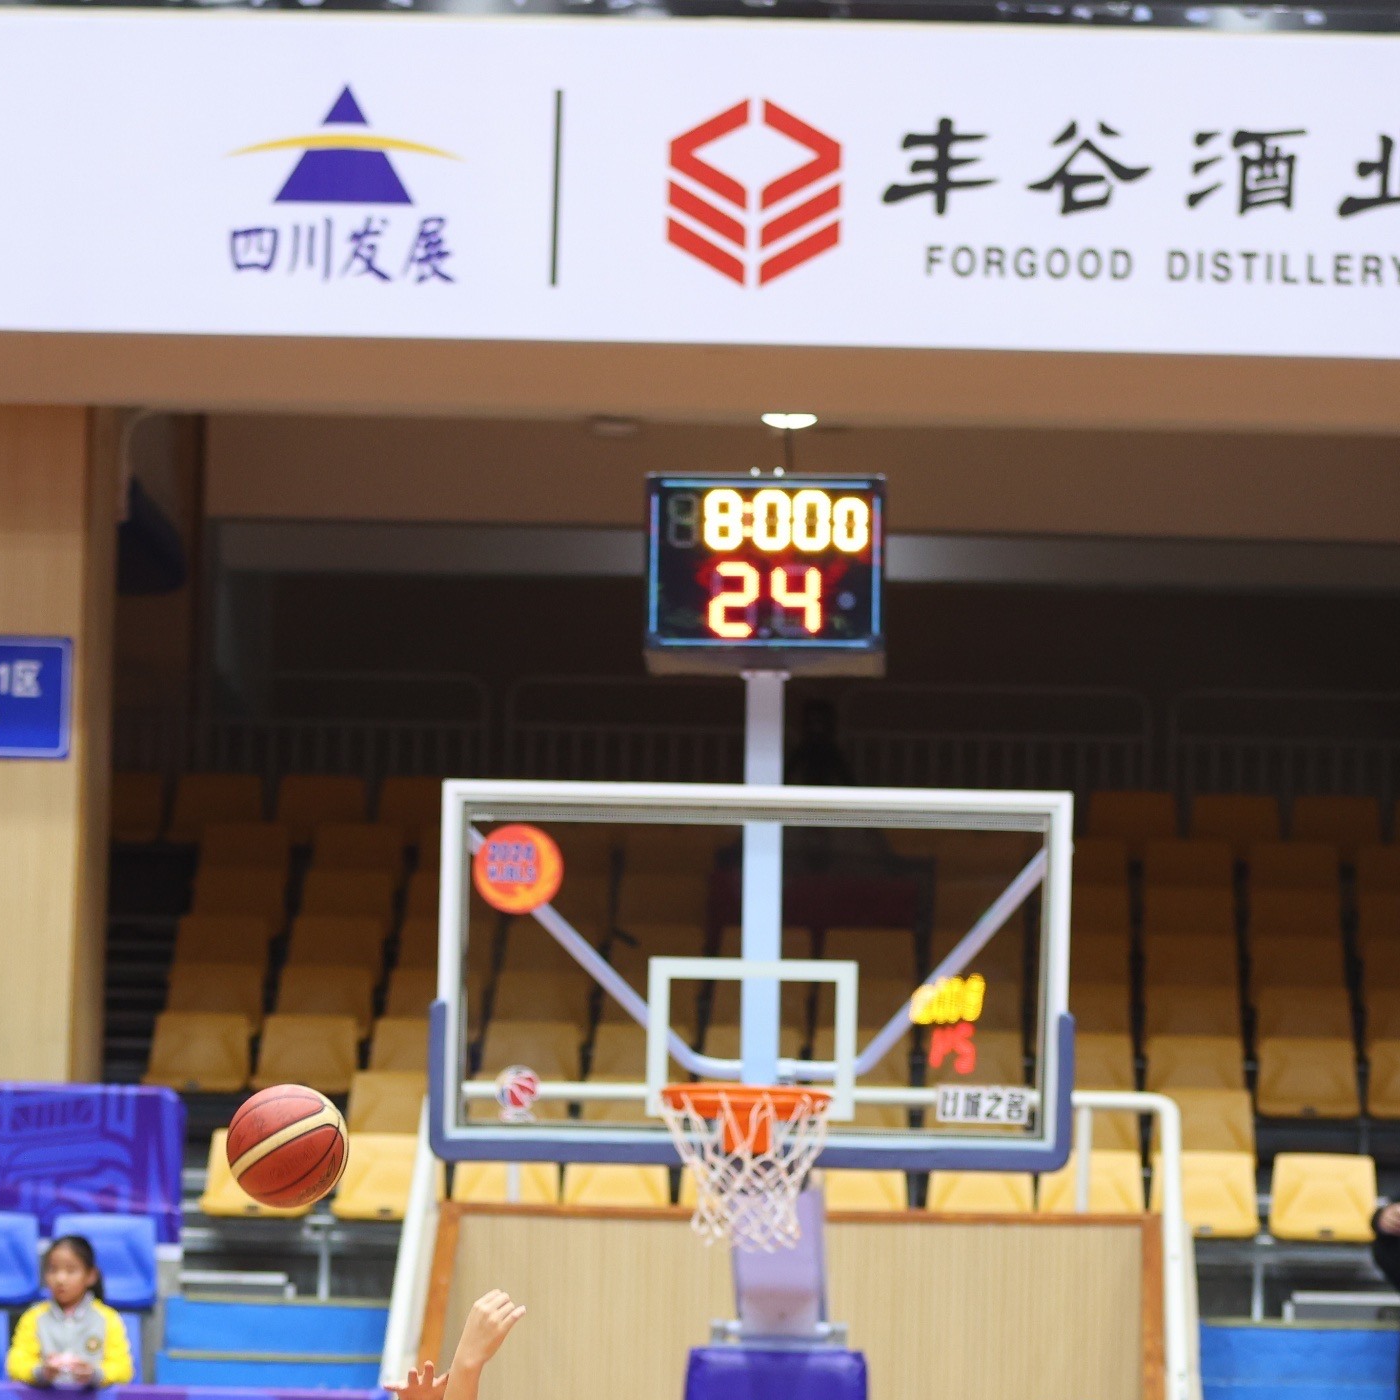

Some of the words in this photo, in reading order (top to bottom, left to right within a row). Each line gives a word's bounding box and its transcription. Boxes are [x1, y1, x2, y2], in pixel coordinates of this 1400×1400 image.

[227, 214, 457, 286] 四川发展
[924, 245, 1134, 281] FORGOOD
[708, 561, 821, 638] 24
